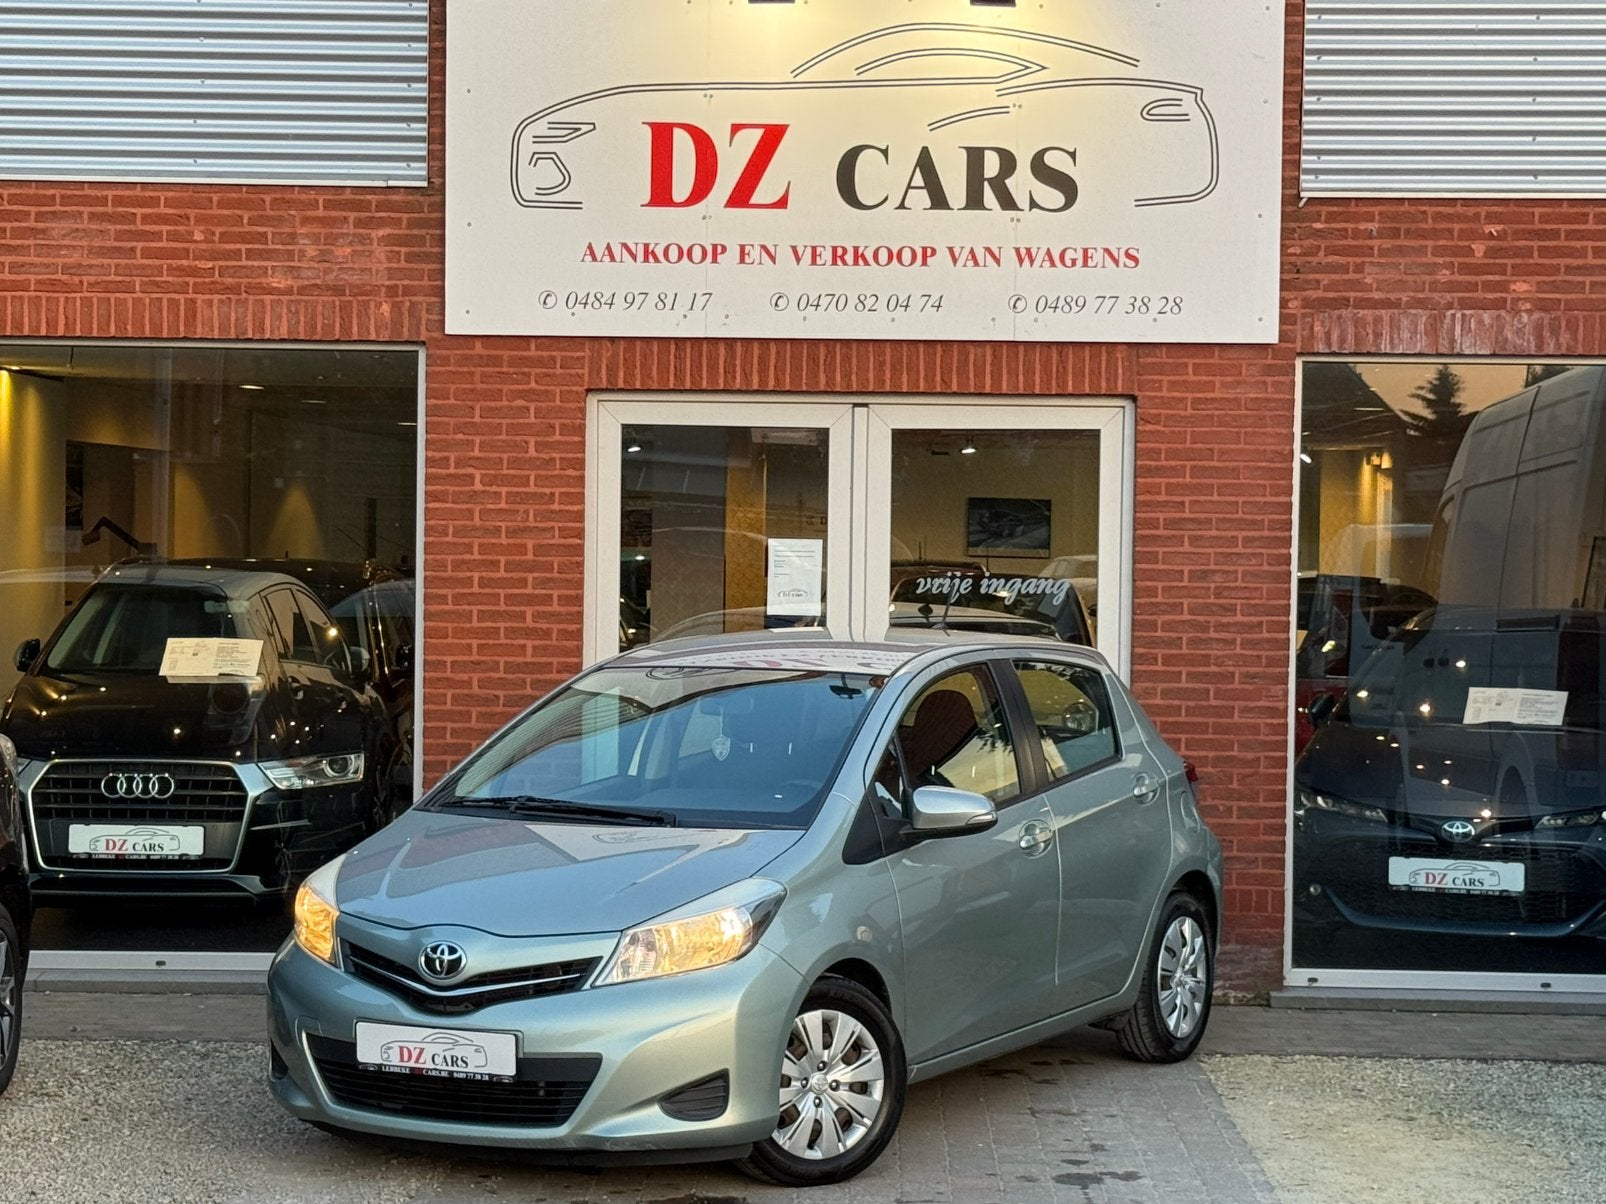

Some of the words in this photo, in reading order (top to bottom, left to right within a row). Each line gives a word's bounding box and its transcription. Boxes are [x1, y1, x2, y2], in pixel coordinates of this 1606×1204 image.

[639, 121, 791, 210] DZ
[835, 144, 1079, 213] CARS
[580, 241, 728, 265] AANKOOP
[737, 243, 779, 266] EN
[789, 244, 937, 268] VERKOOP
[946, 246, 1003, 268] VAN
[1012, 246, 1140, 269] WAGENS
[565, 291, 617, 311] 0484
[622, 292, 649, 311] 97
[654, 292, 678, 312] 81
[687, 292, 714, 312] 17
[797, 293, 849, 313] 0470
[854, 294, 879, 313] 82
[886, 294, 912, 314] 04
[919, 294, 945, 313] 74
[1034, 295, 1087, 315] 0489
[1093, 295, 1120, 316] 77
[1124, 295, 1151, 315] 38
[1156, 296, 1184, 315] 28
[915, 571, 972, 603] vrije
[980, 571, 1071, 605] ingang
[106, 838, 128, 851] DZ
[132, 842, 165, 852] CARS
[1424, 872, 1448, 885] DZ
[1452, 877, 1485, 887] CARS
[398, 1045, 426, 1065] DZ
[431, 1053, 469, 1069] CARS
